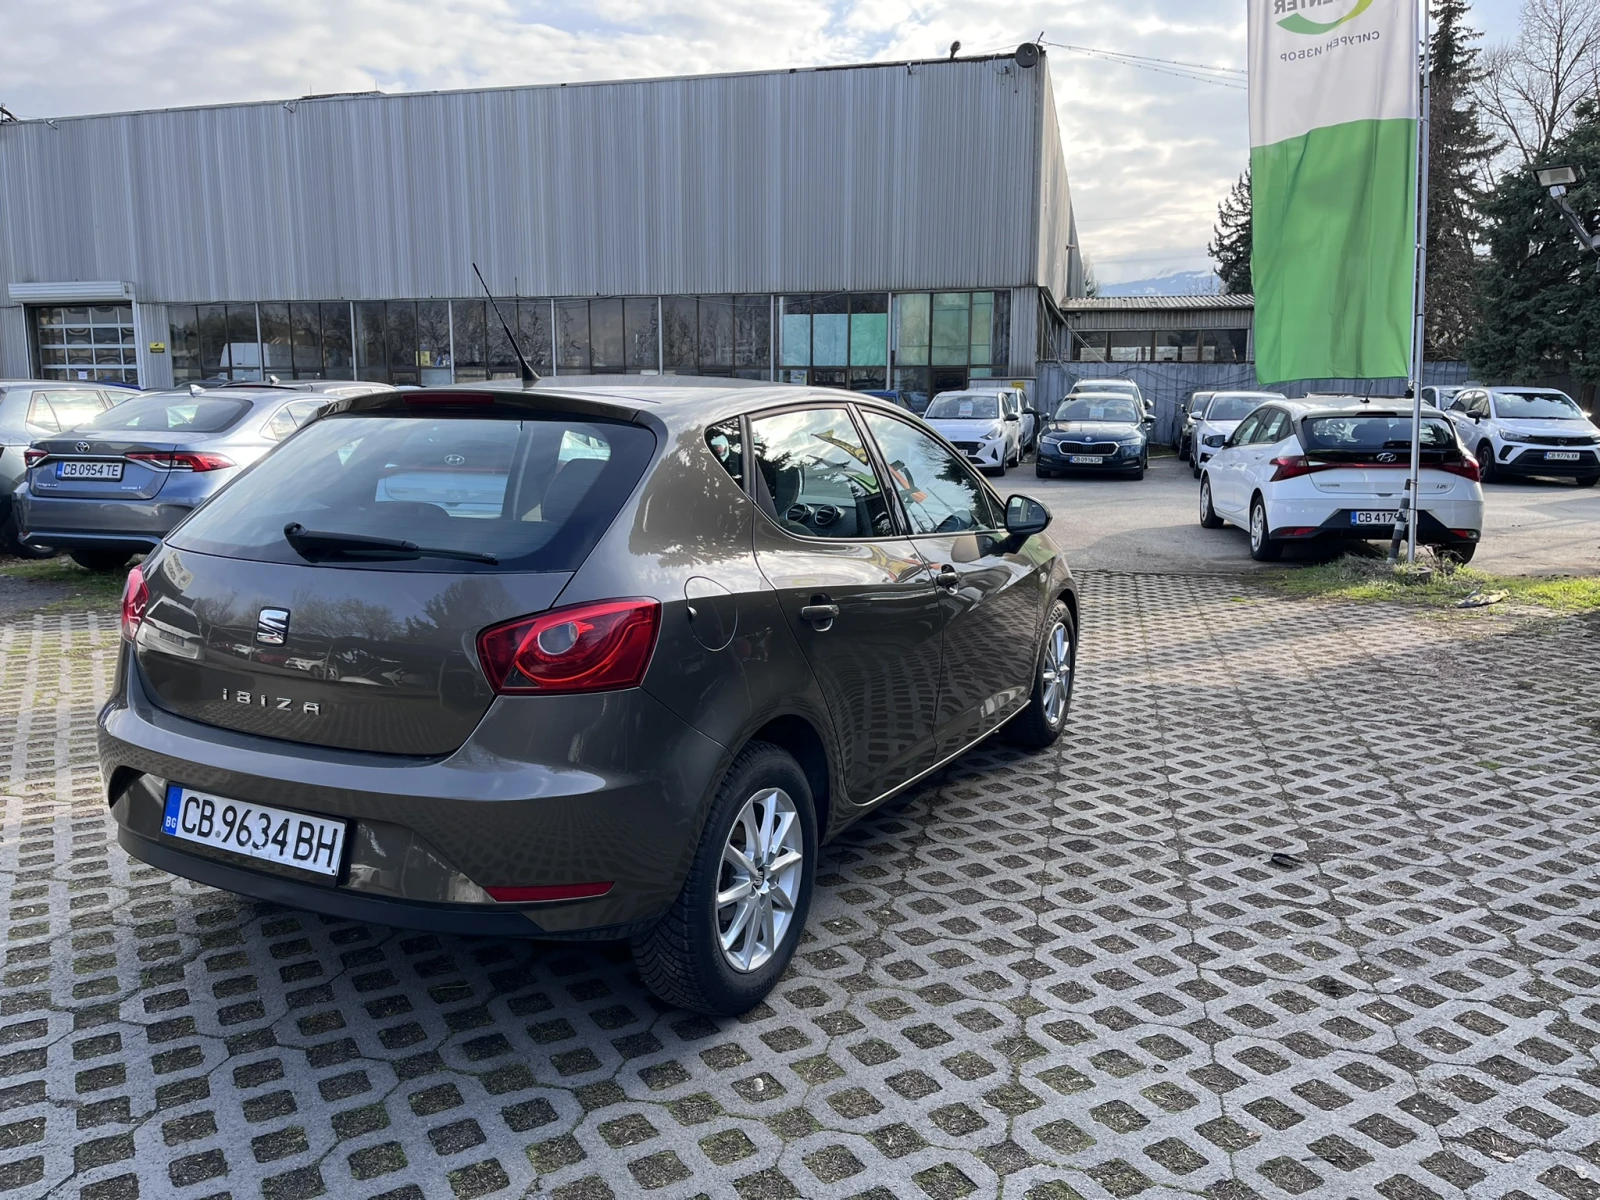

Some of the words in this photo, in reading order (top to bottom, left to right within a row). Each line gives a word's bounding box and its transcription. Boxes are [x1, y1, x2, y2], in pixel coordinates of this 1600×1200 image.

[63, 463, 77, 475] CB
[79, 464, 103, 476] 0954
[106, 465, 119, 476] TE
[1358, 512, 1372, 523] CB
[165, 815, 177, 829] BG
[181, 796, 216, 838] CB
[221, 805, 290, 857] 9634
[293, 820, 338, 868] BH
